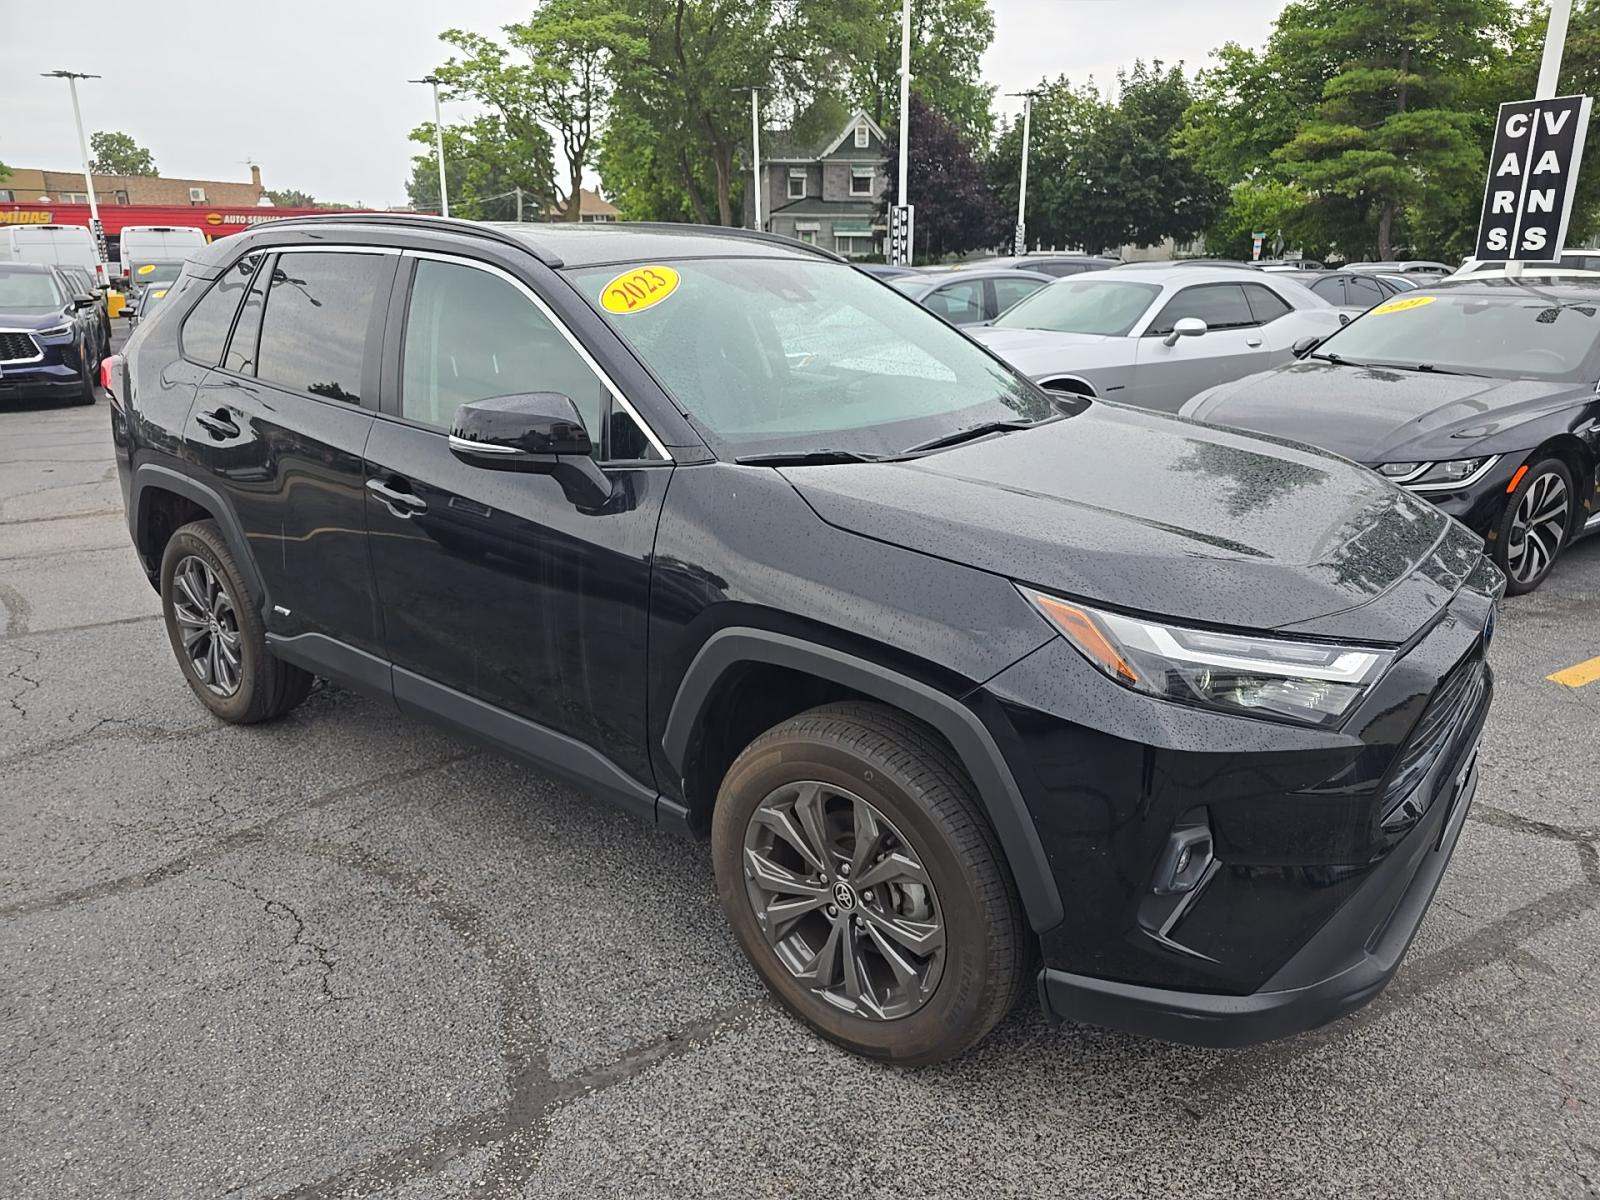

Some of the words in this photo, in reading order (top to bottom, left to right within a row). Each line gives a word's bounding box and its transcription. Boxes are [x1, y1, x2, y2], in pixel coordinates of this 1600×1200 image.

[224, 215, 246, 224] AUTO
[1486, 113, 1529, 251] CARS
[1522, 109, 1572, 251] VANS
[611, 269, 667, 309] 2023
